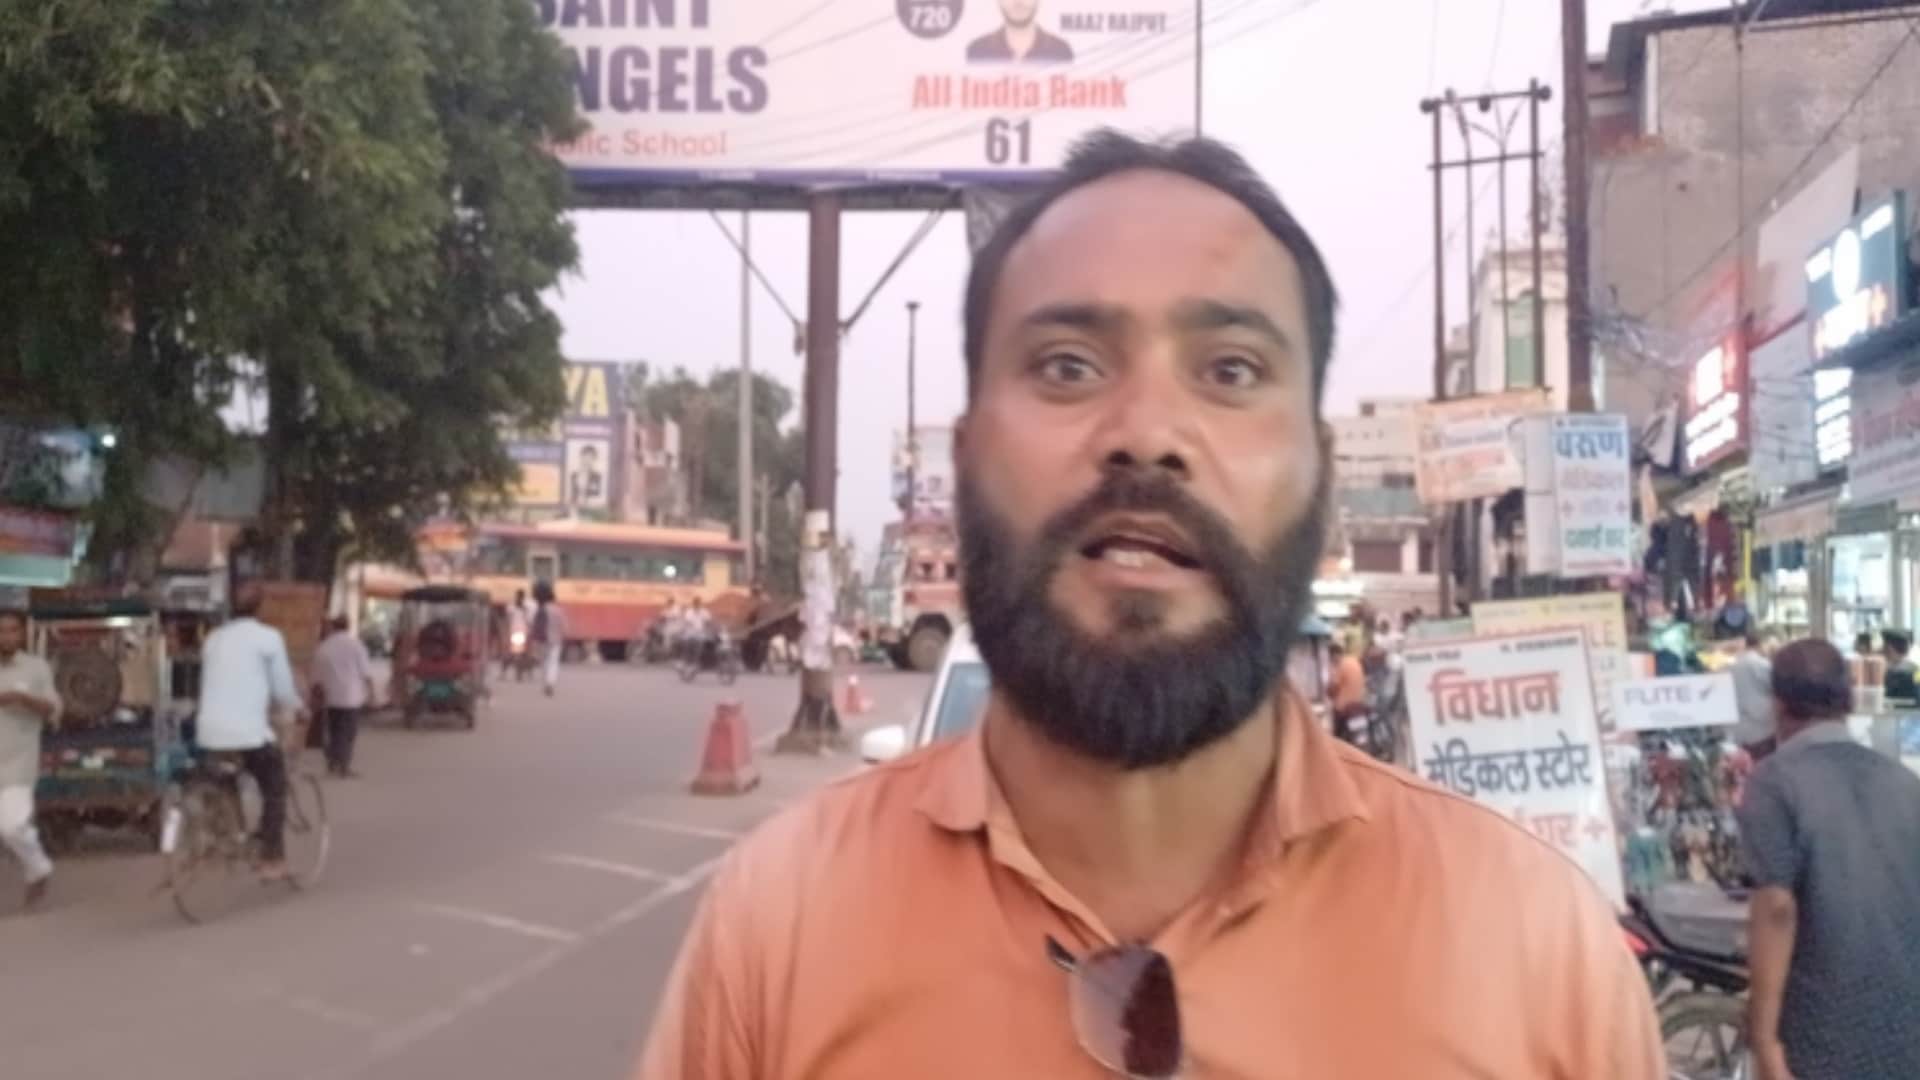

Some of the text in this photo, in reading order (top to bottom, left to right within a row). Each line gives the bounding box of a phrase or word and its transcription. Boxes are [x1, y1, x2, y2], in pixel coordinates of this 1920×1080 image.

[913, 75, 1127, 109] All India Rank
[623, 130, 728, 156] School
[984, 117, 1031, 165] 61
[1428, 668, 1561, 726] विधान
